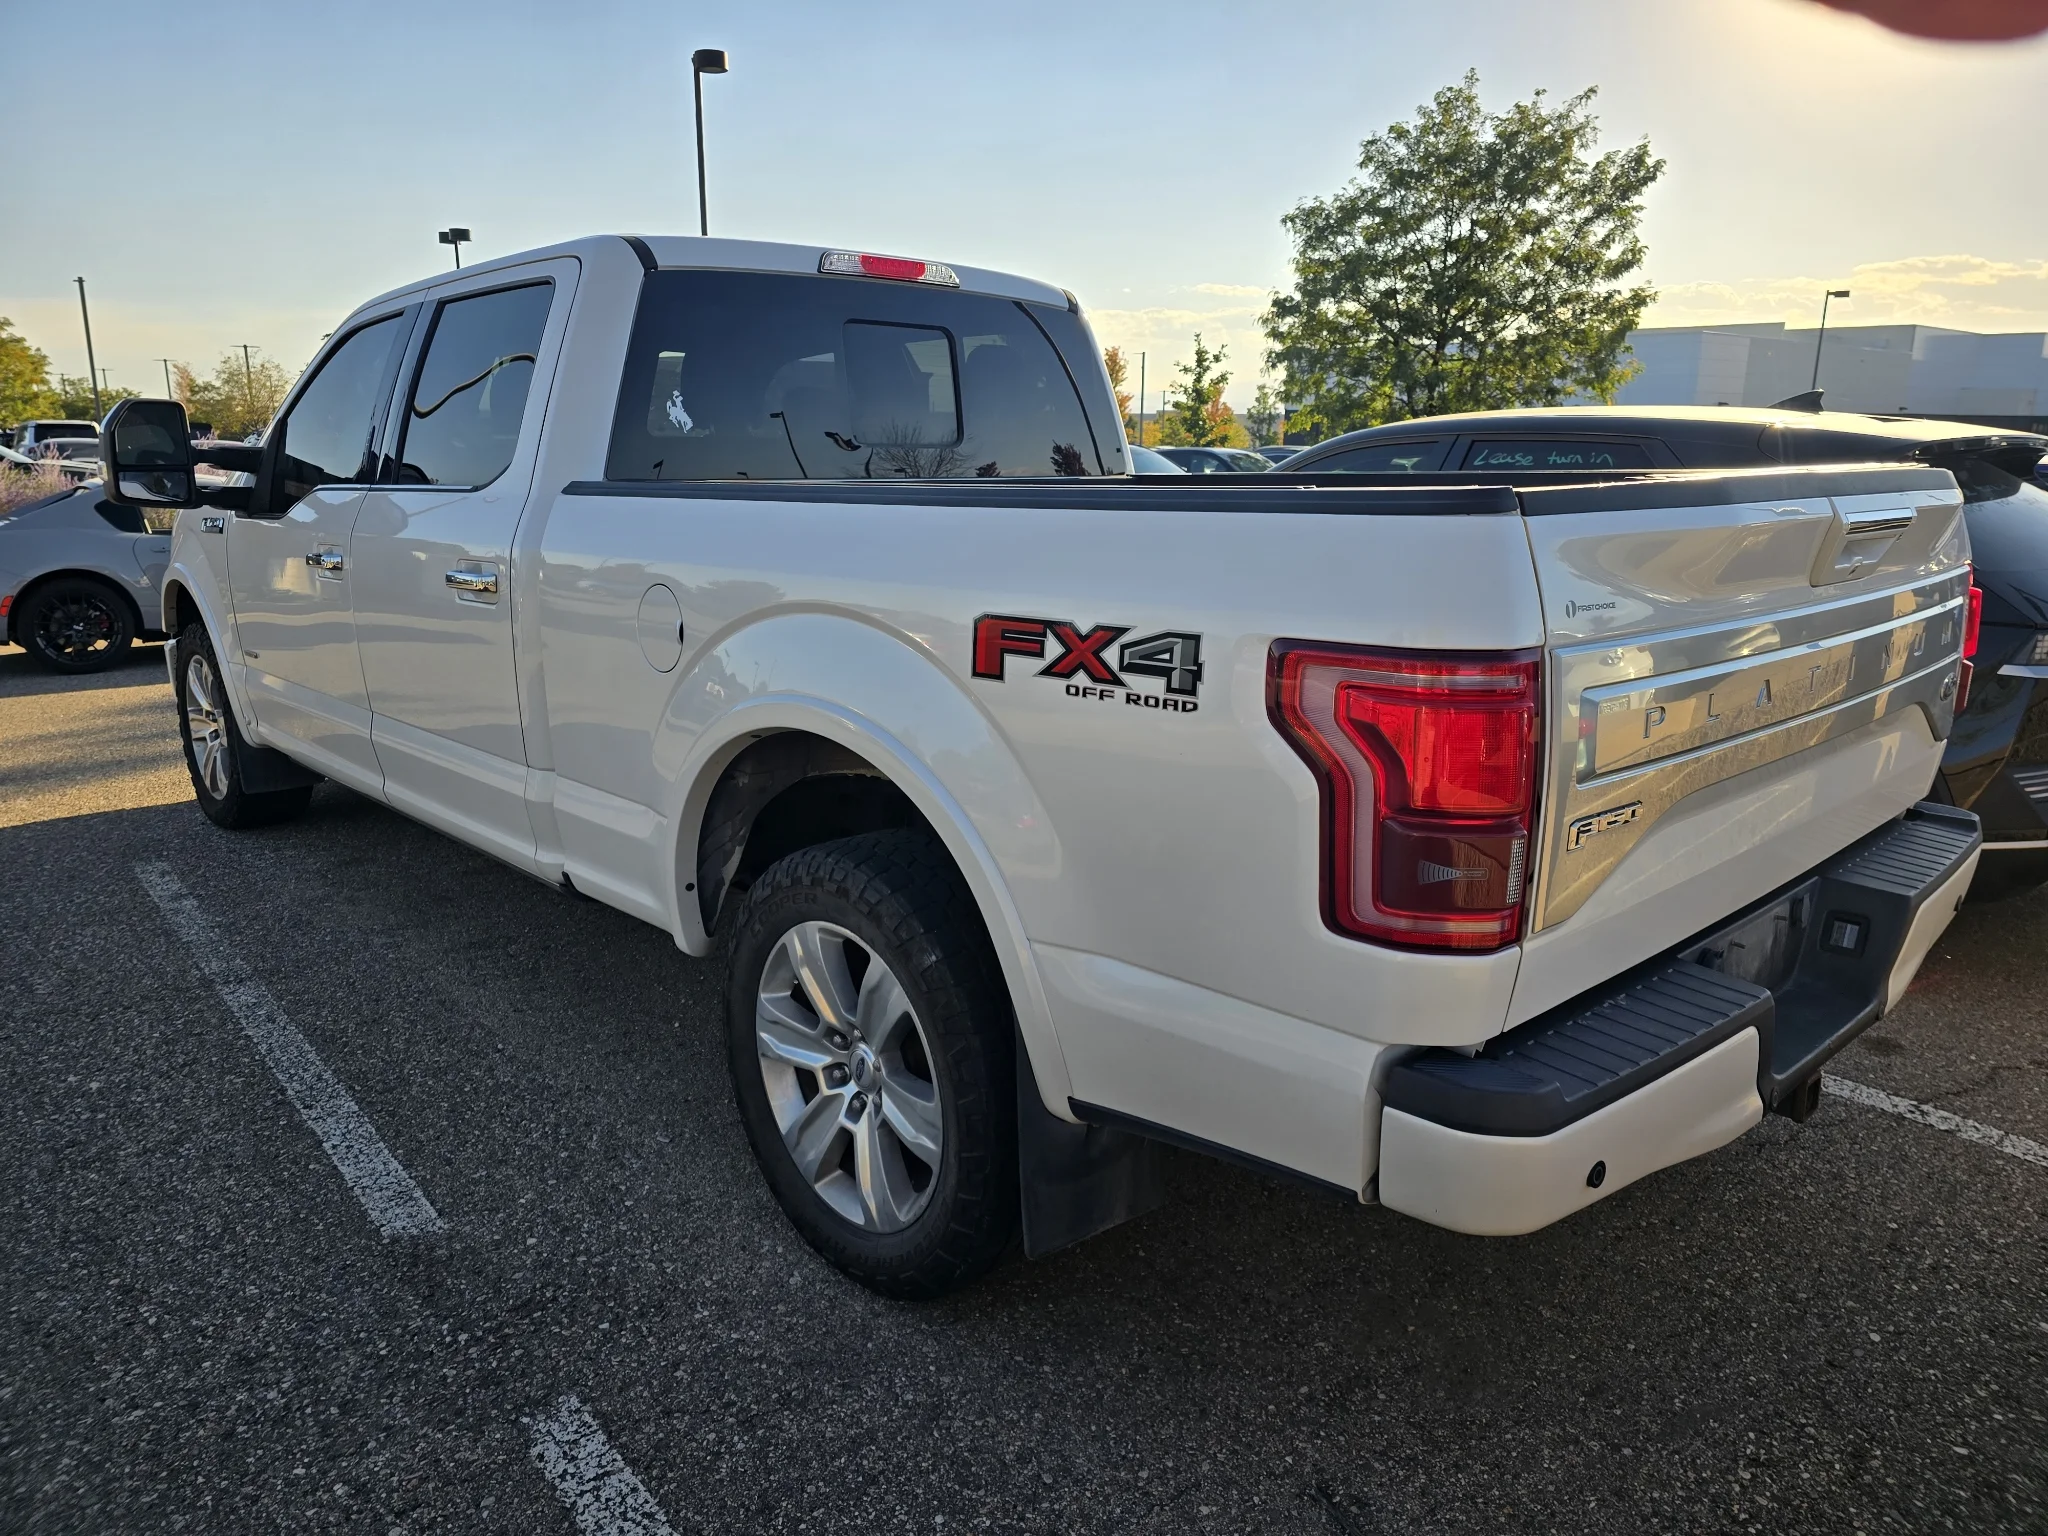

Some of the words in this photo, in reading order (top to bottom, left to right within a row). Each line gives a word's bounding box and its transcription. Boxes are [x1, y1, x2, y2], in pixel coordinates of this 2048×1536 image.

[1474, 450, 1534, 466] Lease
[1547, 452, 1583, 464] turn
[1590, 452, 1613, 467] in
[971, 611, 1205, 698] FX4
[1643, 617, 1952, 739] PLATINUM
[1066, 684, 1115, 701] OFF
[1125, 692, 1198, 713] ROAD
